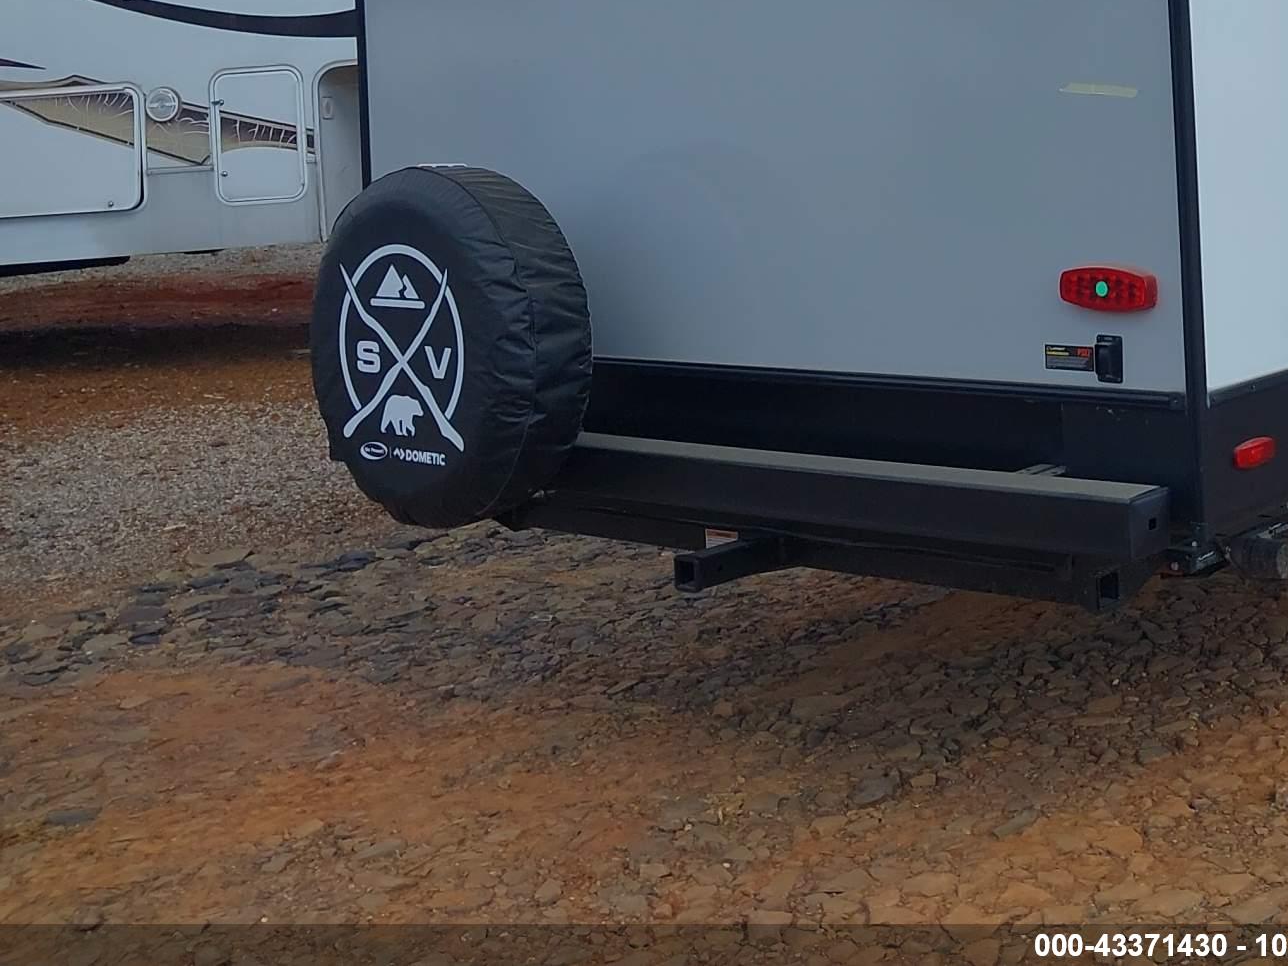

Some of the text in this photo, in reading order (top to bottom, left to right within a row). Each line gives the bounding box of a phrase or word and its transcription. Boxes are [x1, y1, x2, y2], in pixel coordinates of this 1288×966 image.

[356, 340, 452, 379] S V
[405, 449, 446, 466] DOMETIC
